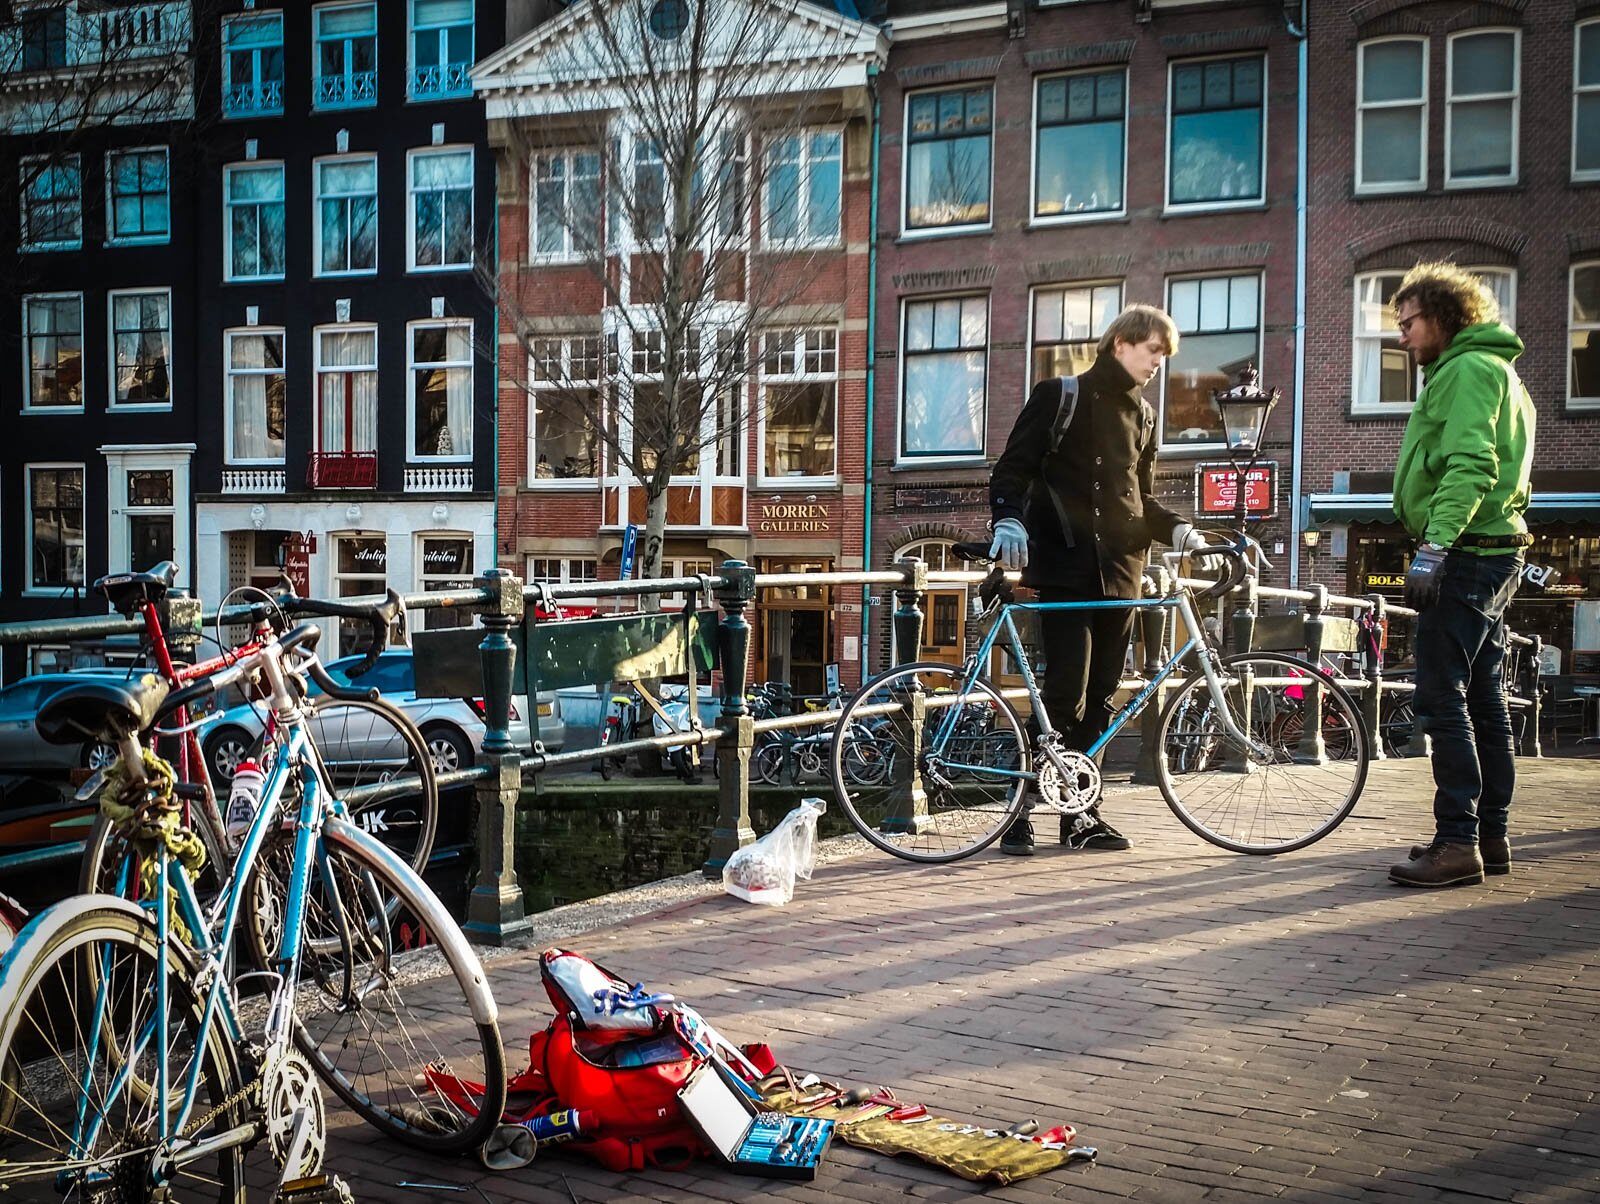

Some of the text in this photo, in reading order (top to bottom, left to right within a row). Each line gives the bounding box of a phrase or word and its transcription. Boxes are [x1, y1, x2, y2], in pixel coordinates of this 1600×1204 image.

[1228, 472, 1263, 481] HUR
[762, 504, 829, 518] MORREN
[760, 521, 830, 532] GALLERIES
[355, 548, 387, 565] Antiq
[1367, 575, 1406, 586] BOLS
